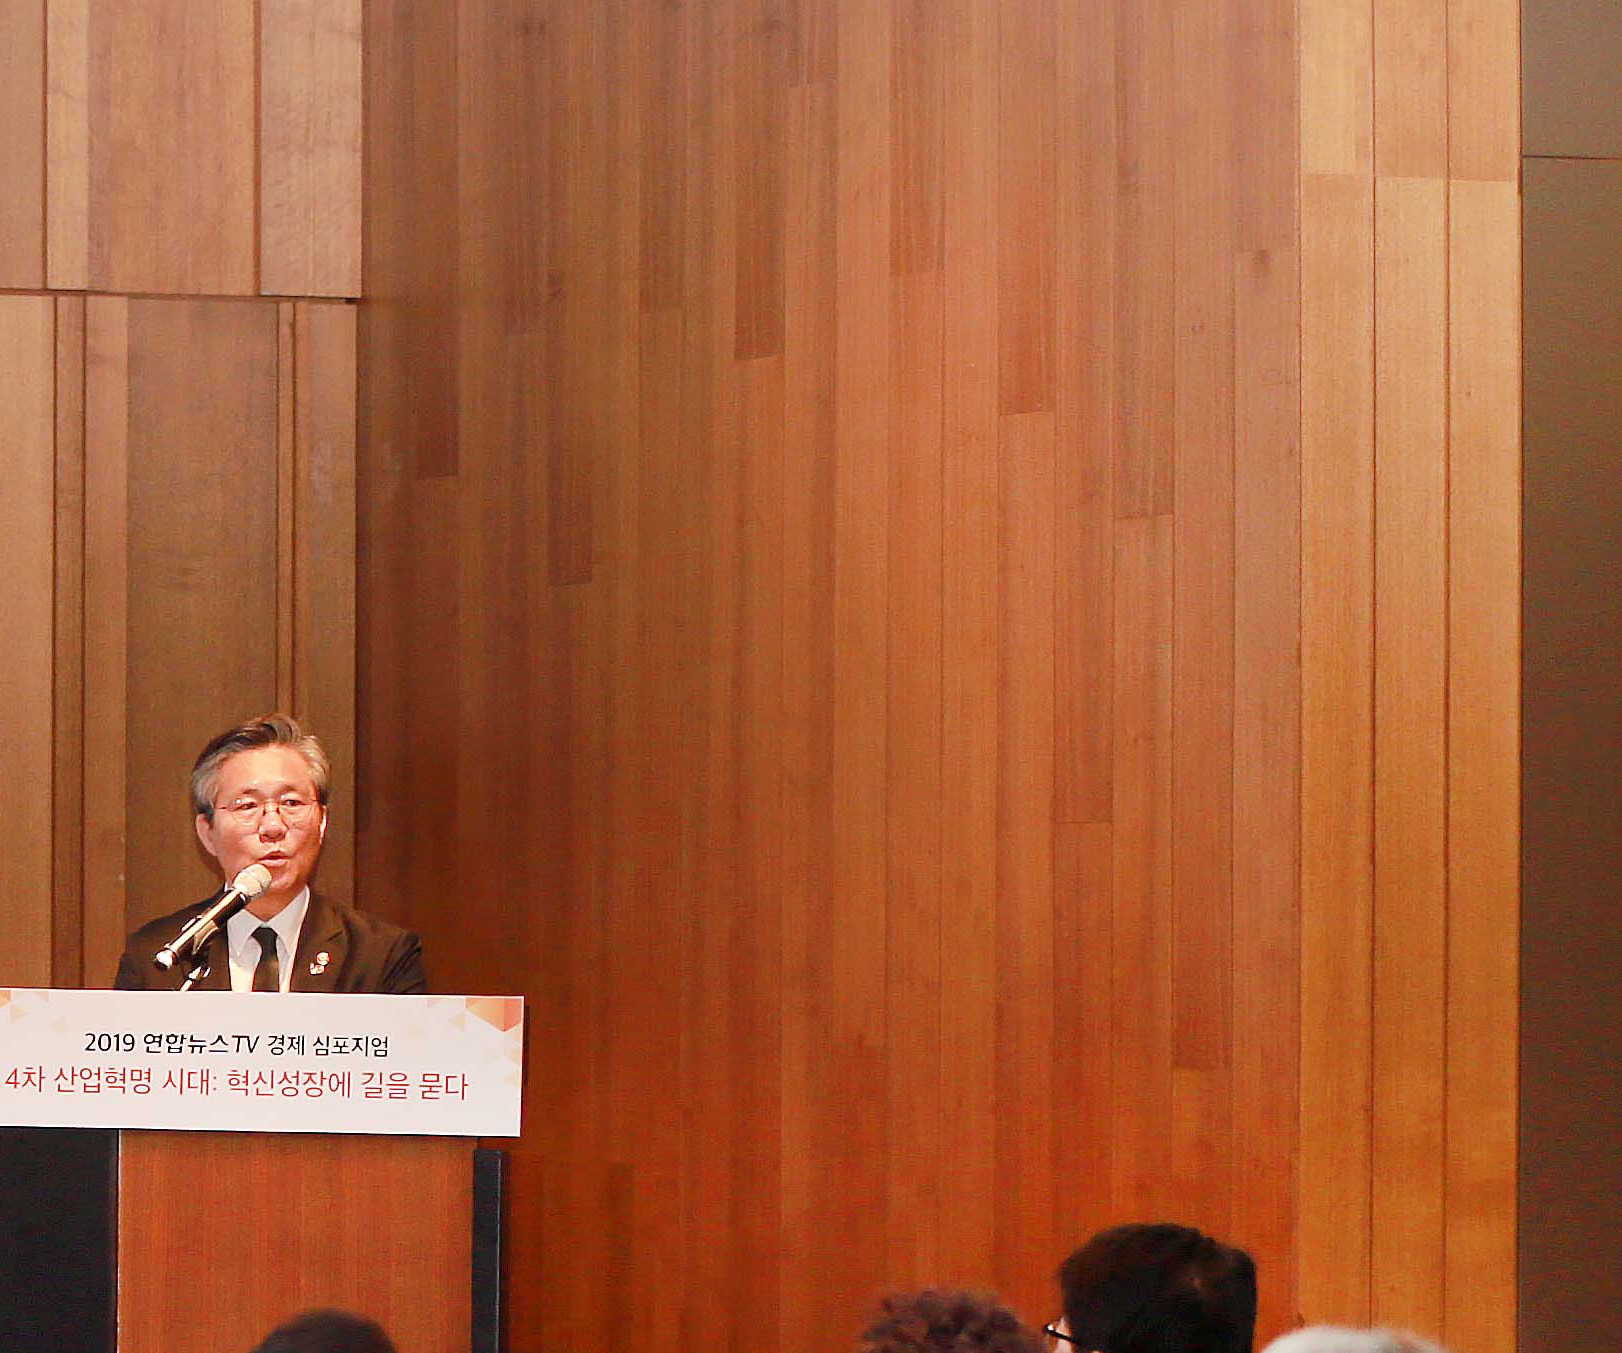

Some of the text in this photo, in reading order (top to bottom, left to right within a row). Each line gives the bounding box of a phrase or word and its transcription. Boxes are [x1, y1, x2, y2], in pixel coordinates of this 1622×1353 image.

[85, 1032, 388, 1058] 2019 연합뉴스TV 경제 심포지엄
[4, 1065, 469, 1101] 4차 산업혁명 시대: 혁신성장에 길을 묻다
